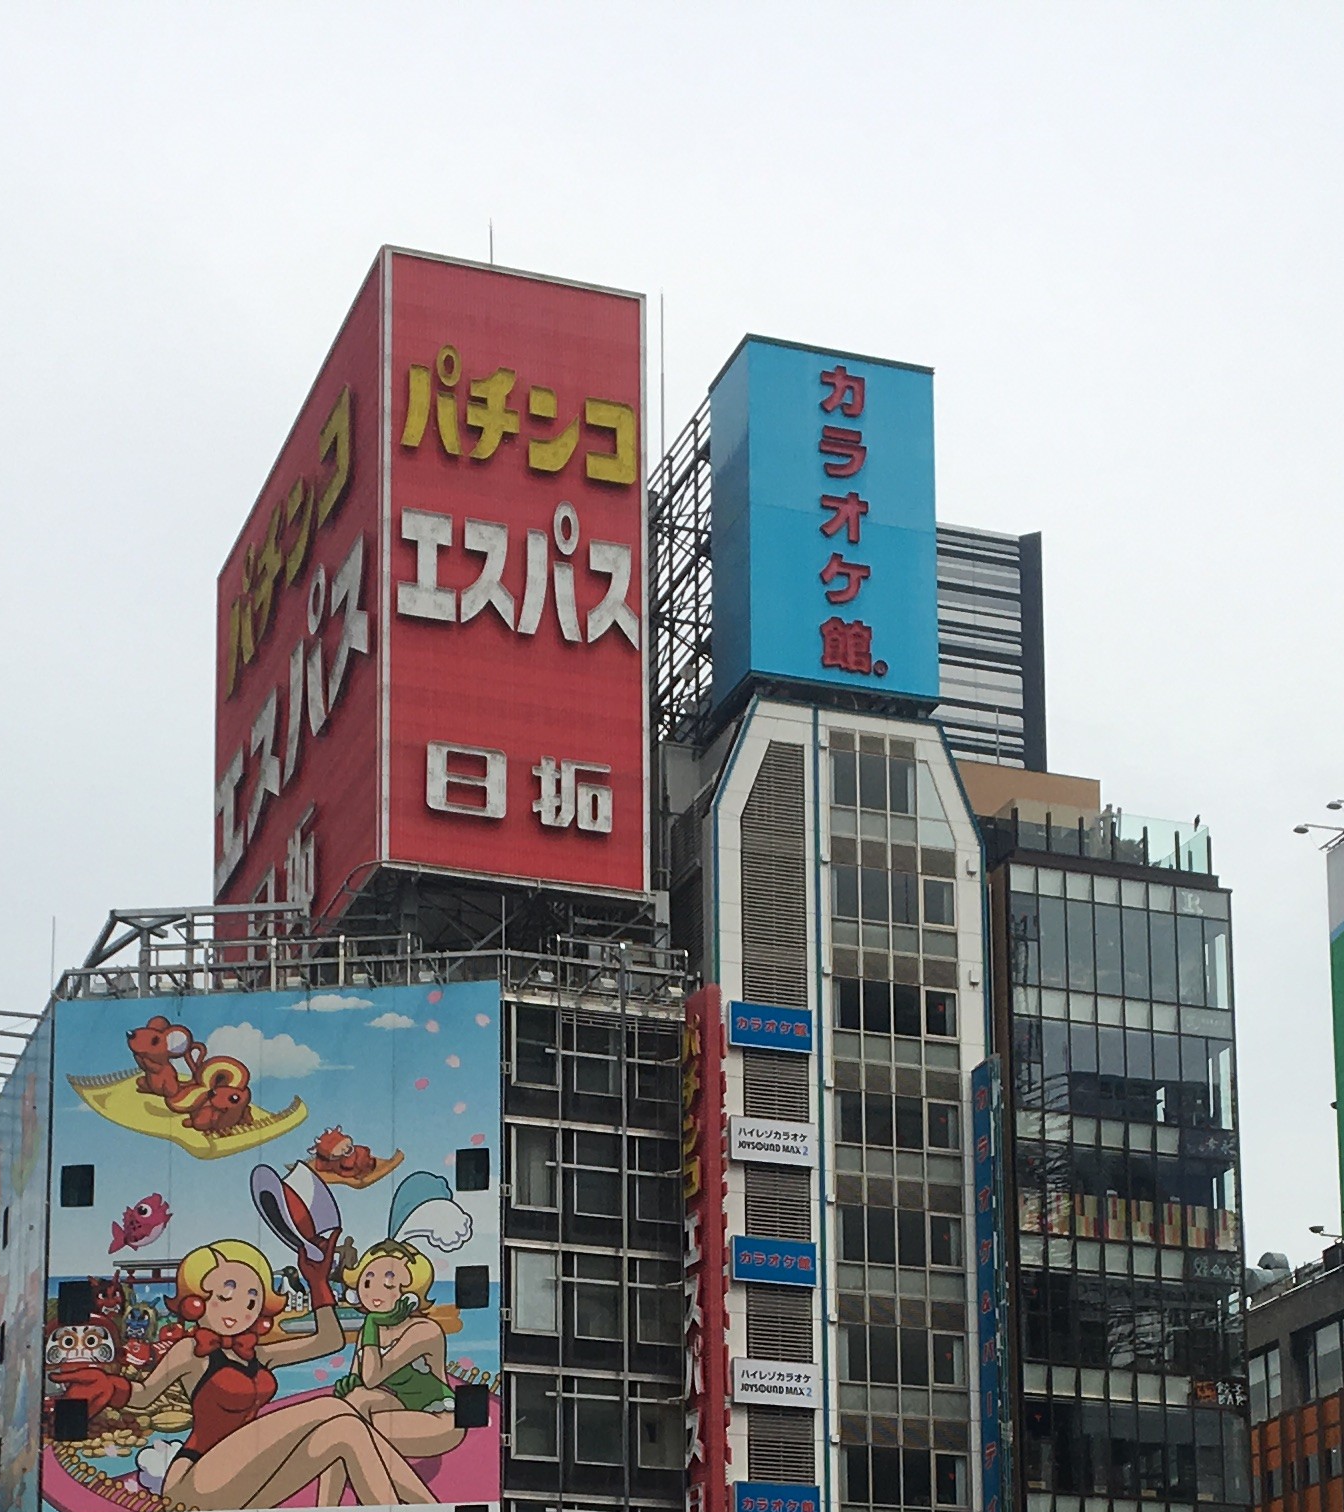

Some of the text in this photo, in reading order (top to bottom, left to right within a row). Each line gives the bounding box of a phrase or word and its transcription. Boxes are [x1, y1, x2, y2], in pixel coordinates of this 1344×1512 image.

[399, 344, 638, 486] パチンコ
[225, 383, 352, 701] パチンコ
[396, 500, 641, 652] エスパス
[214, 530, 370, 897] エスパス
[426, 739, 614, 835] 日拓
[737, 1126, 808, 1143] ハイレゾカラオケ
[737, 1140, 780, 1154] JOYSOUND
[740, 1368, 812, 1384] ハイレゾカラオケ
[740, 1382, 783, 1396] JOYSOUND
